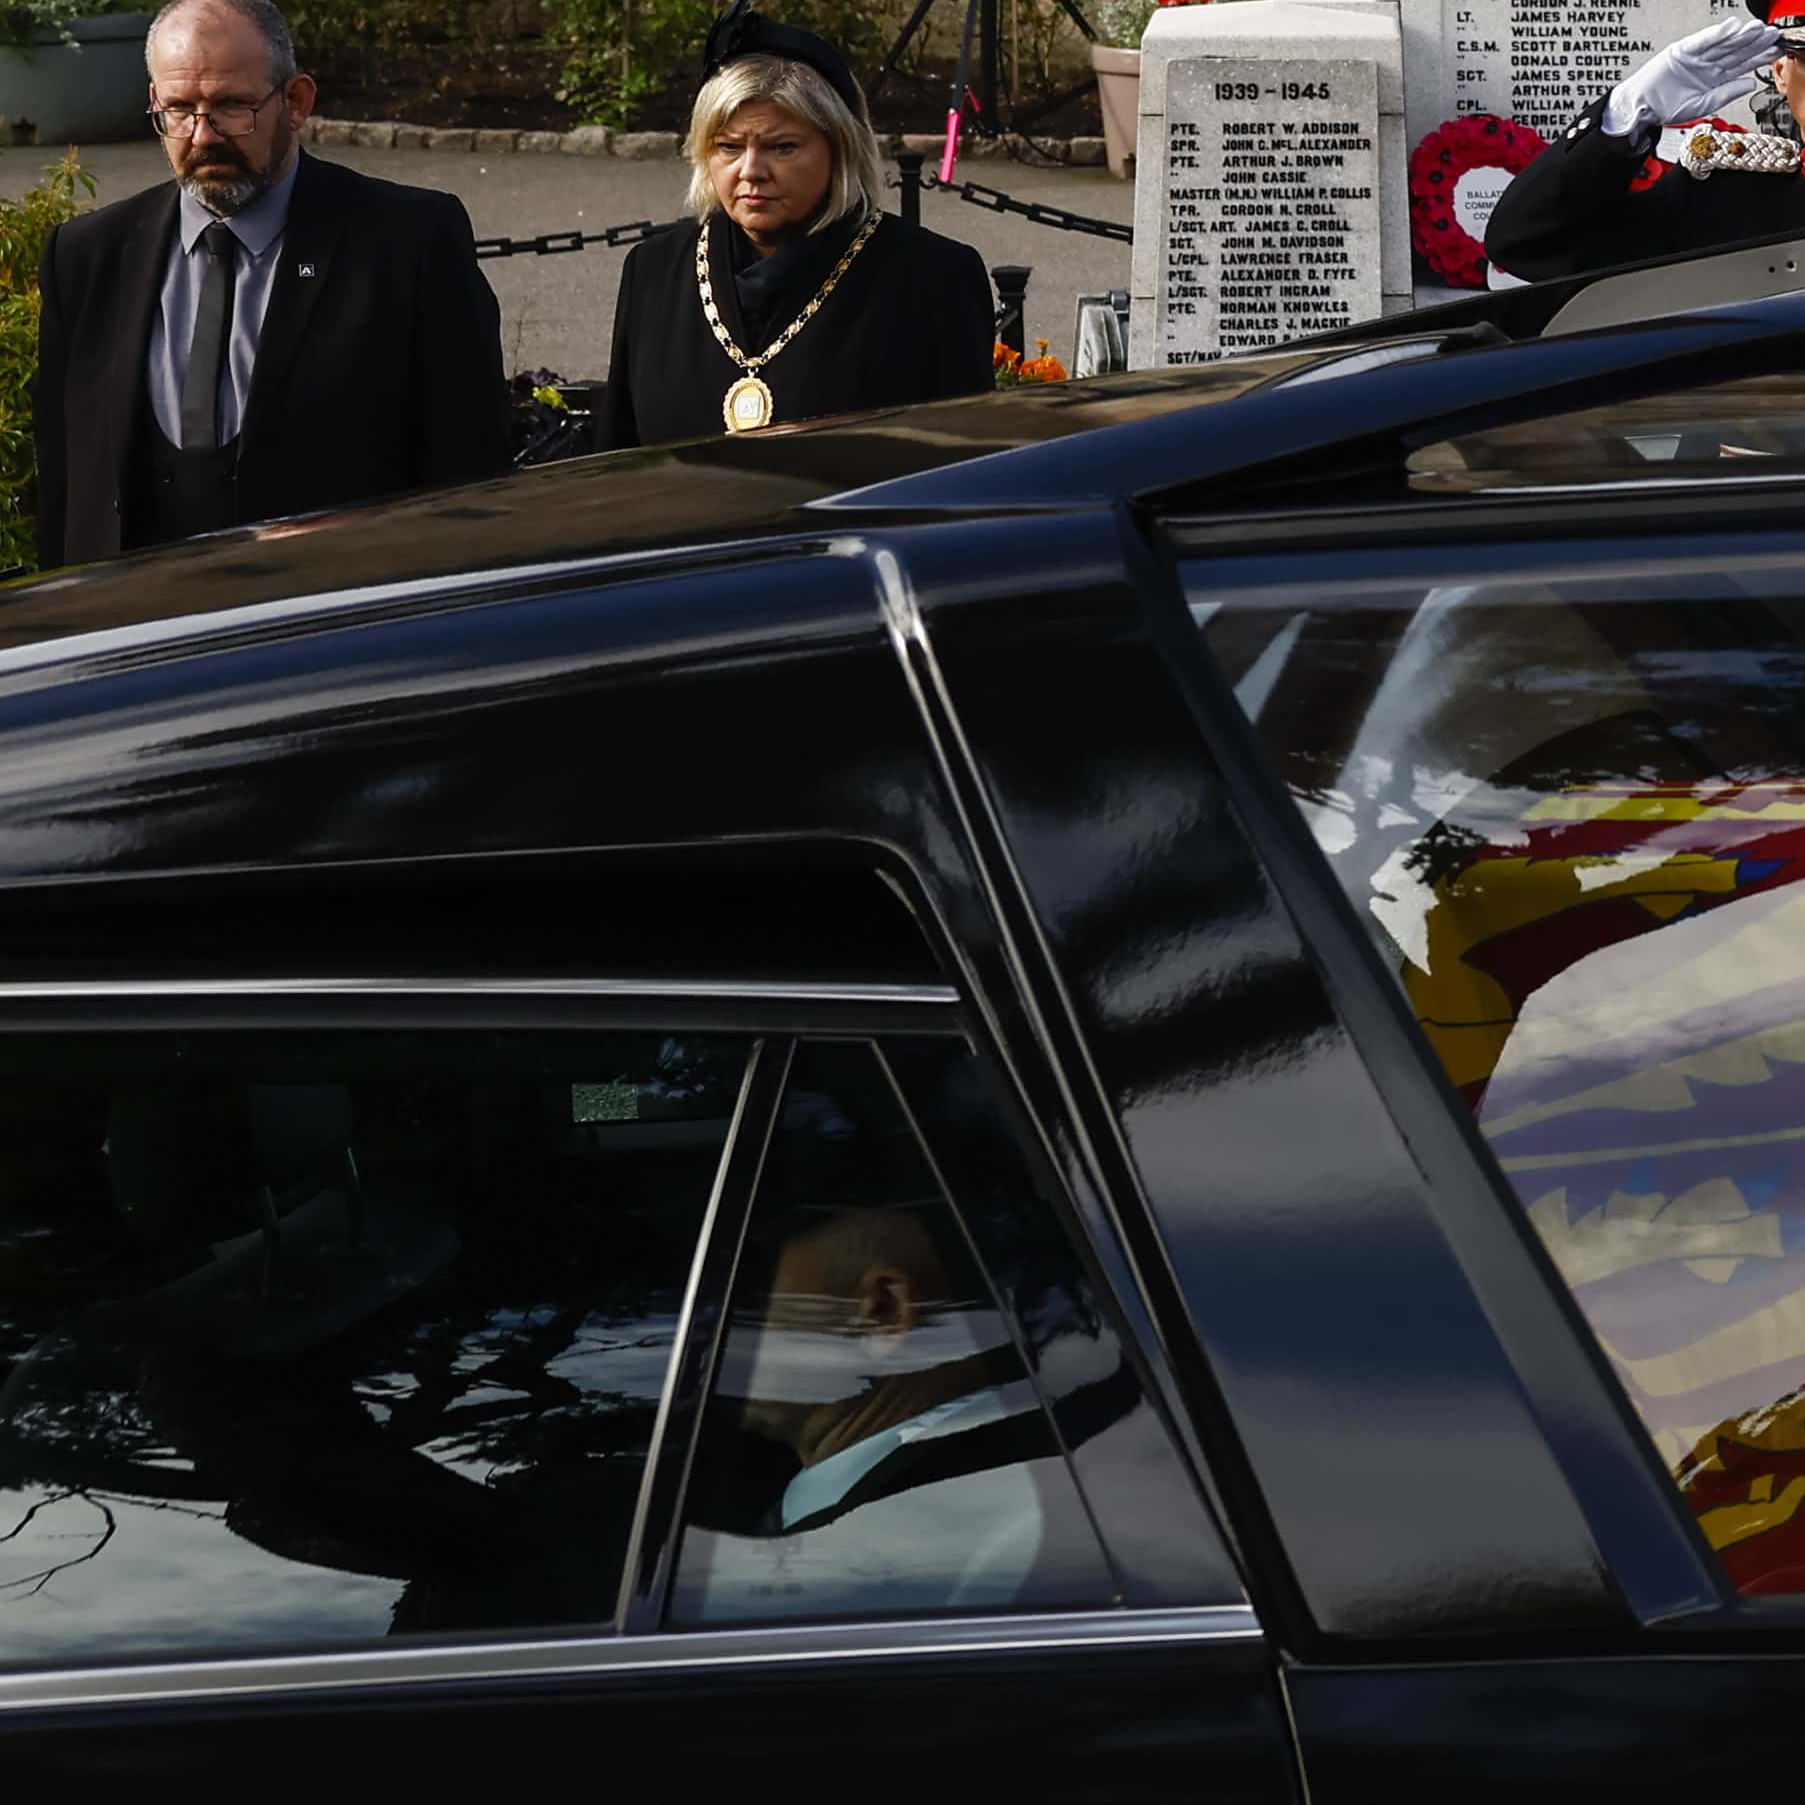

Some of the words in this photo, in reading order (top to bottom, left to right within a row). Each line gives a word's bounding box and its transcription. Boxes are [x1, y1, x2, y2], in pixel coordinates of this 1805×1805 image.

[1511, 12, 1560, 22] JAMES
[1568, 12, 1624, 23] HARVEY
[1512, 27, 1572, 37] WILLIAM
[1580, 27, 1627, 37] YOUNG
[1512, 41, 1556, 51] SCOTT
[1511, 56, 1568, 66] DONALD
[1576, 56, 1629, 66] COUTTS
[1511, 70, 1560, 81] JAMES
[1568, 70, 1621, 81] SPENCE
[1216, 83, 1258, 100] 1939
[1282, 83, 1330, 99] 1945
[1512, 85, 1570, 96] ARTHUR
[1512, 100, 1574, 110] WILLIAM
[1223, 123, 1275, 134] ROBERT
[1302, 123, 1358, 134] ADDISON
[1222, 140, 1253, 150] JOHN
[1223, 156, 1275, 167] ARTHUR
[1296, 156, 1343, 167] BROWN
[1223, 172, 1256, 183] JOHN
[1263, 172, 1306, 183] CASSIE
[1170, 189, 1220, 200] MASTER
[1261, 188, 1314, 199] WILLIAM
[1222, 205, 1273, 215] GORDON
[1296, 204, 1336, 215] CROLL
[1245, 221, 1289, 232] JAMES
[1312, 220, 1351, 231] CROLL
[1222, 238, 1254, 248] JOHN
[1280, 236, 1344, 248] DAVIDSON
[1221, 253, 1290, 264] LAWRENCE
[1299, 252, 1348, 264] FRASER
[1221, 269, 1300, 281] ALEXANDER
[1324, 269, 1355, 279] FYFE
[1221, 286, 1272, 297] ROBERT
[1280, 286, 1330, 296] INGRAM
[1220, 302, 1276, 313] NORMAN
[1283, 302, 1348, 313] KNOWLES
[1220, 319, 1278, 330] CHARLES
[1219, 335, 1275, 346] EDWARD
